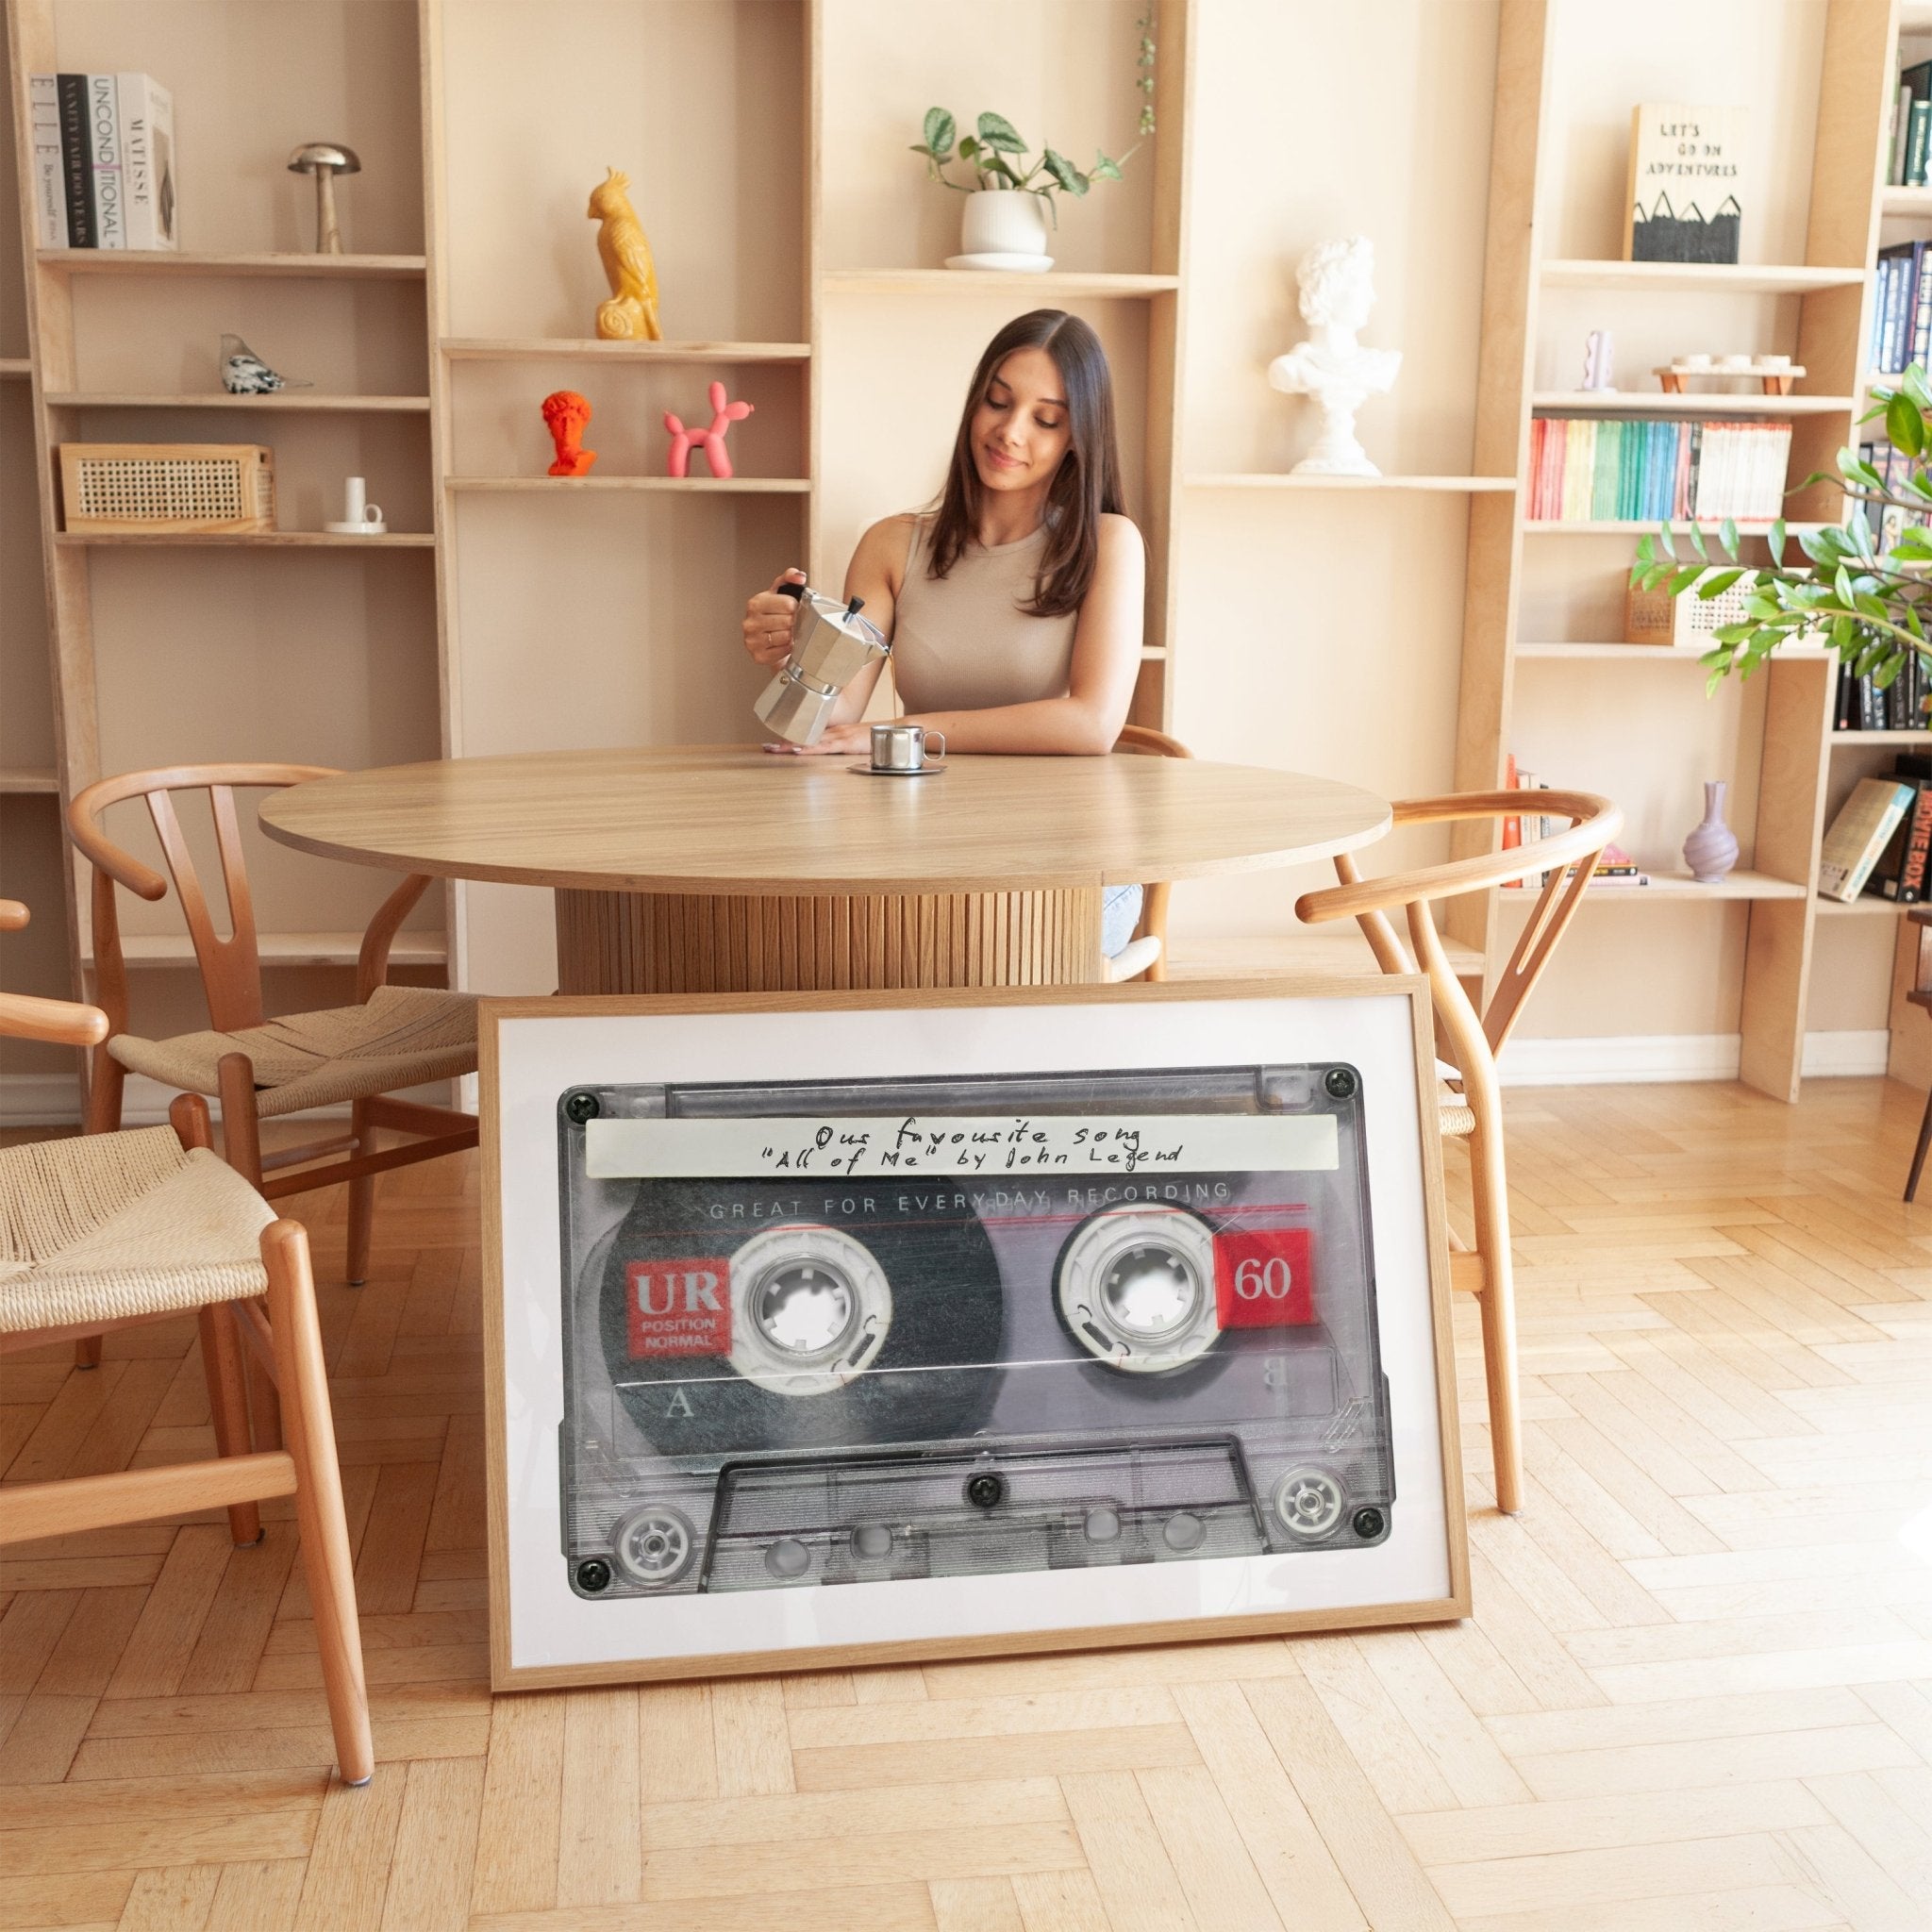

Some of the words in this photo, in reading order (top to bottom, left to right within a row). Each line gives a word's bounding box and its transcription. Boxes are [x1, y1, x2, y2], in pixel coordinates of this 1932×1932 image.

[31, 77, 59, 154] ELLE
[1660, 124, 1699, 137] LET'S
[93, 78, 118, 238] UNCONDITIONAL
[130, 119, 148, 205] MATISSE
[1678, 143, 1696, 156] GO
[1704, 143, 1721, 156] ON
[1646, 162, 1737, 176] ADVENTURES
[75, 199, 87, 244] YEARS
[1904, 851, 1929, 889] BOX
[1073, 1127, 1141, 1151] song
[761, 1146, 814, 1169] "All
[831, 1147, 866, 1175] of
[881, 1144, 937, 1167] Me"
[957, 1149, 987, 1171] by
[1006, 1146, 1068, 1169] John
[1090, 1145, 1184, 1172] Legend
[709, 1201, 801, 1220] GREAT
[824, 1198, 875, 1214] FOR
[898, 1191, 1046, 1211] EVERYDAY
[1068, 1181, 1229, 1204] RECORDING
[634, 1271, 724, 1315] UR
[1235, 1257, 1291, 1300] 60
[641, 1317, 716, 1333] POSITION
[644, 1335, 712, 1349] NORMAL
[666, 1386, 694, 1417] A
